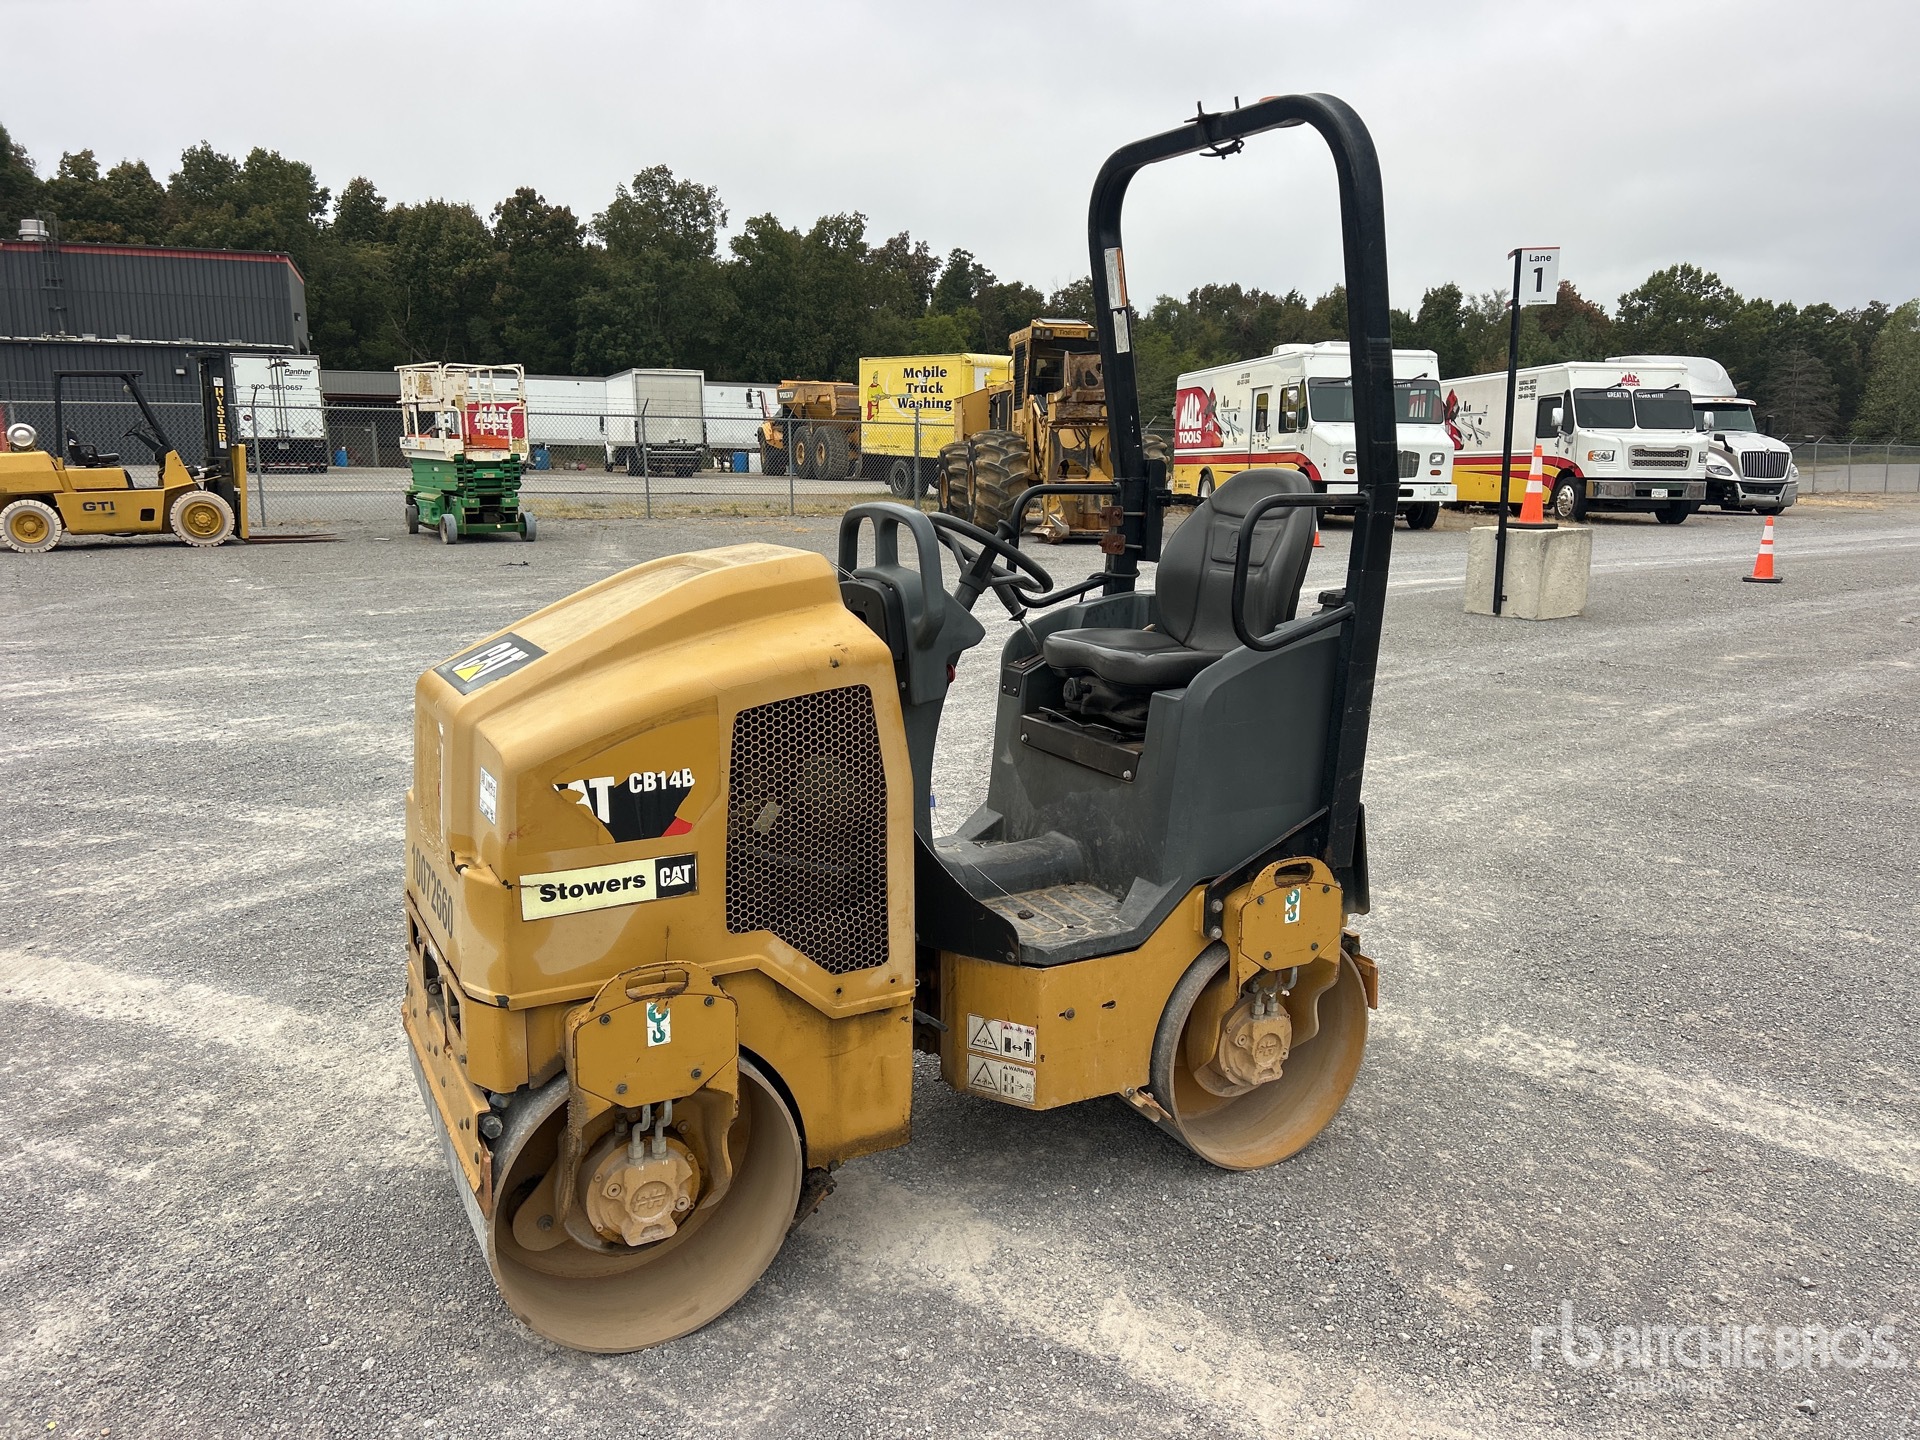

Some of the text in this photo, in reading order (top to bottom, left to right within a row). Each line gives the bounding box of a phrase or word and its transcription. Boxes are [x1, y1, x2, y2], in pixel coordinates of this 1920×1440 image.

[1529, 254, 1552, 262] Lane
[1533, 267, 1544, 293] 1
[902, 365, 948, 379] Mobile
[1621, 374, 1640, 383] MAC
[906, 381, 944, 395] Truck
[897, 396, 953, 412] Washing
[1179, 393, 1203, 430] MAC
[214, 387, 228, 442] HYSTER
[1178, 431, 1202, 444] TOOLS
[82, 501, 115, 512] GTI
[451, 641, 530, 683] CAT
[628, 767, 696, 794] CB14B
[411, 842, 454, 939] 10072660
[539, 862, 694, 903] Stowers CAT
[1009, 1065, 1034, 1076] WARNING
